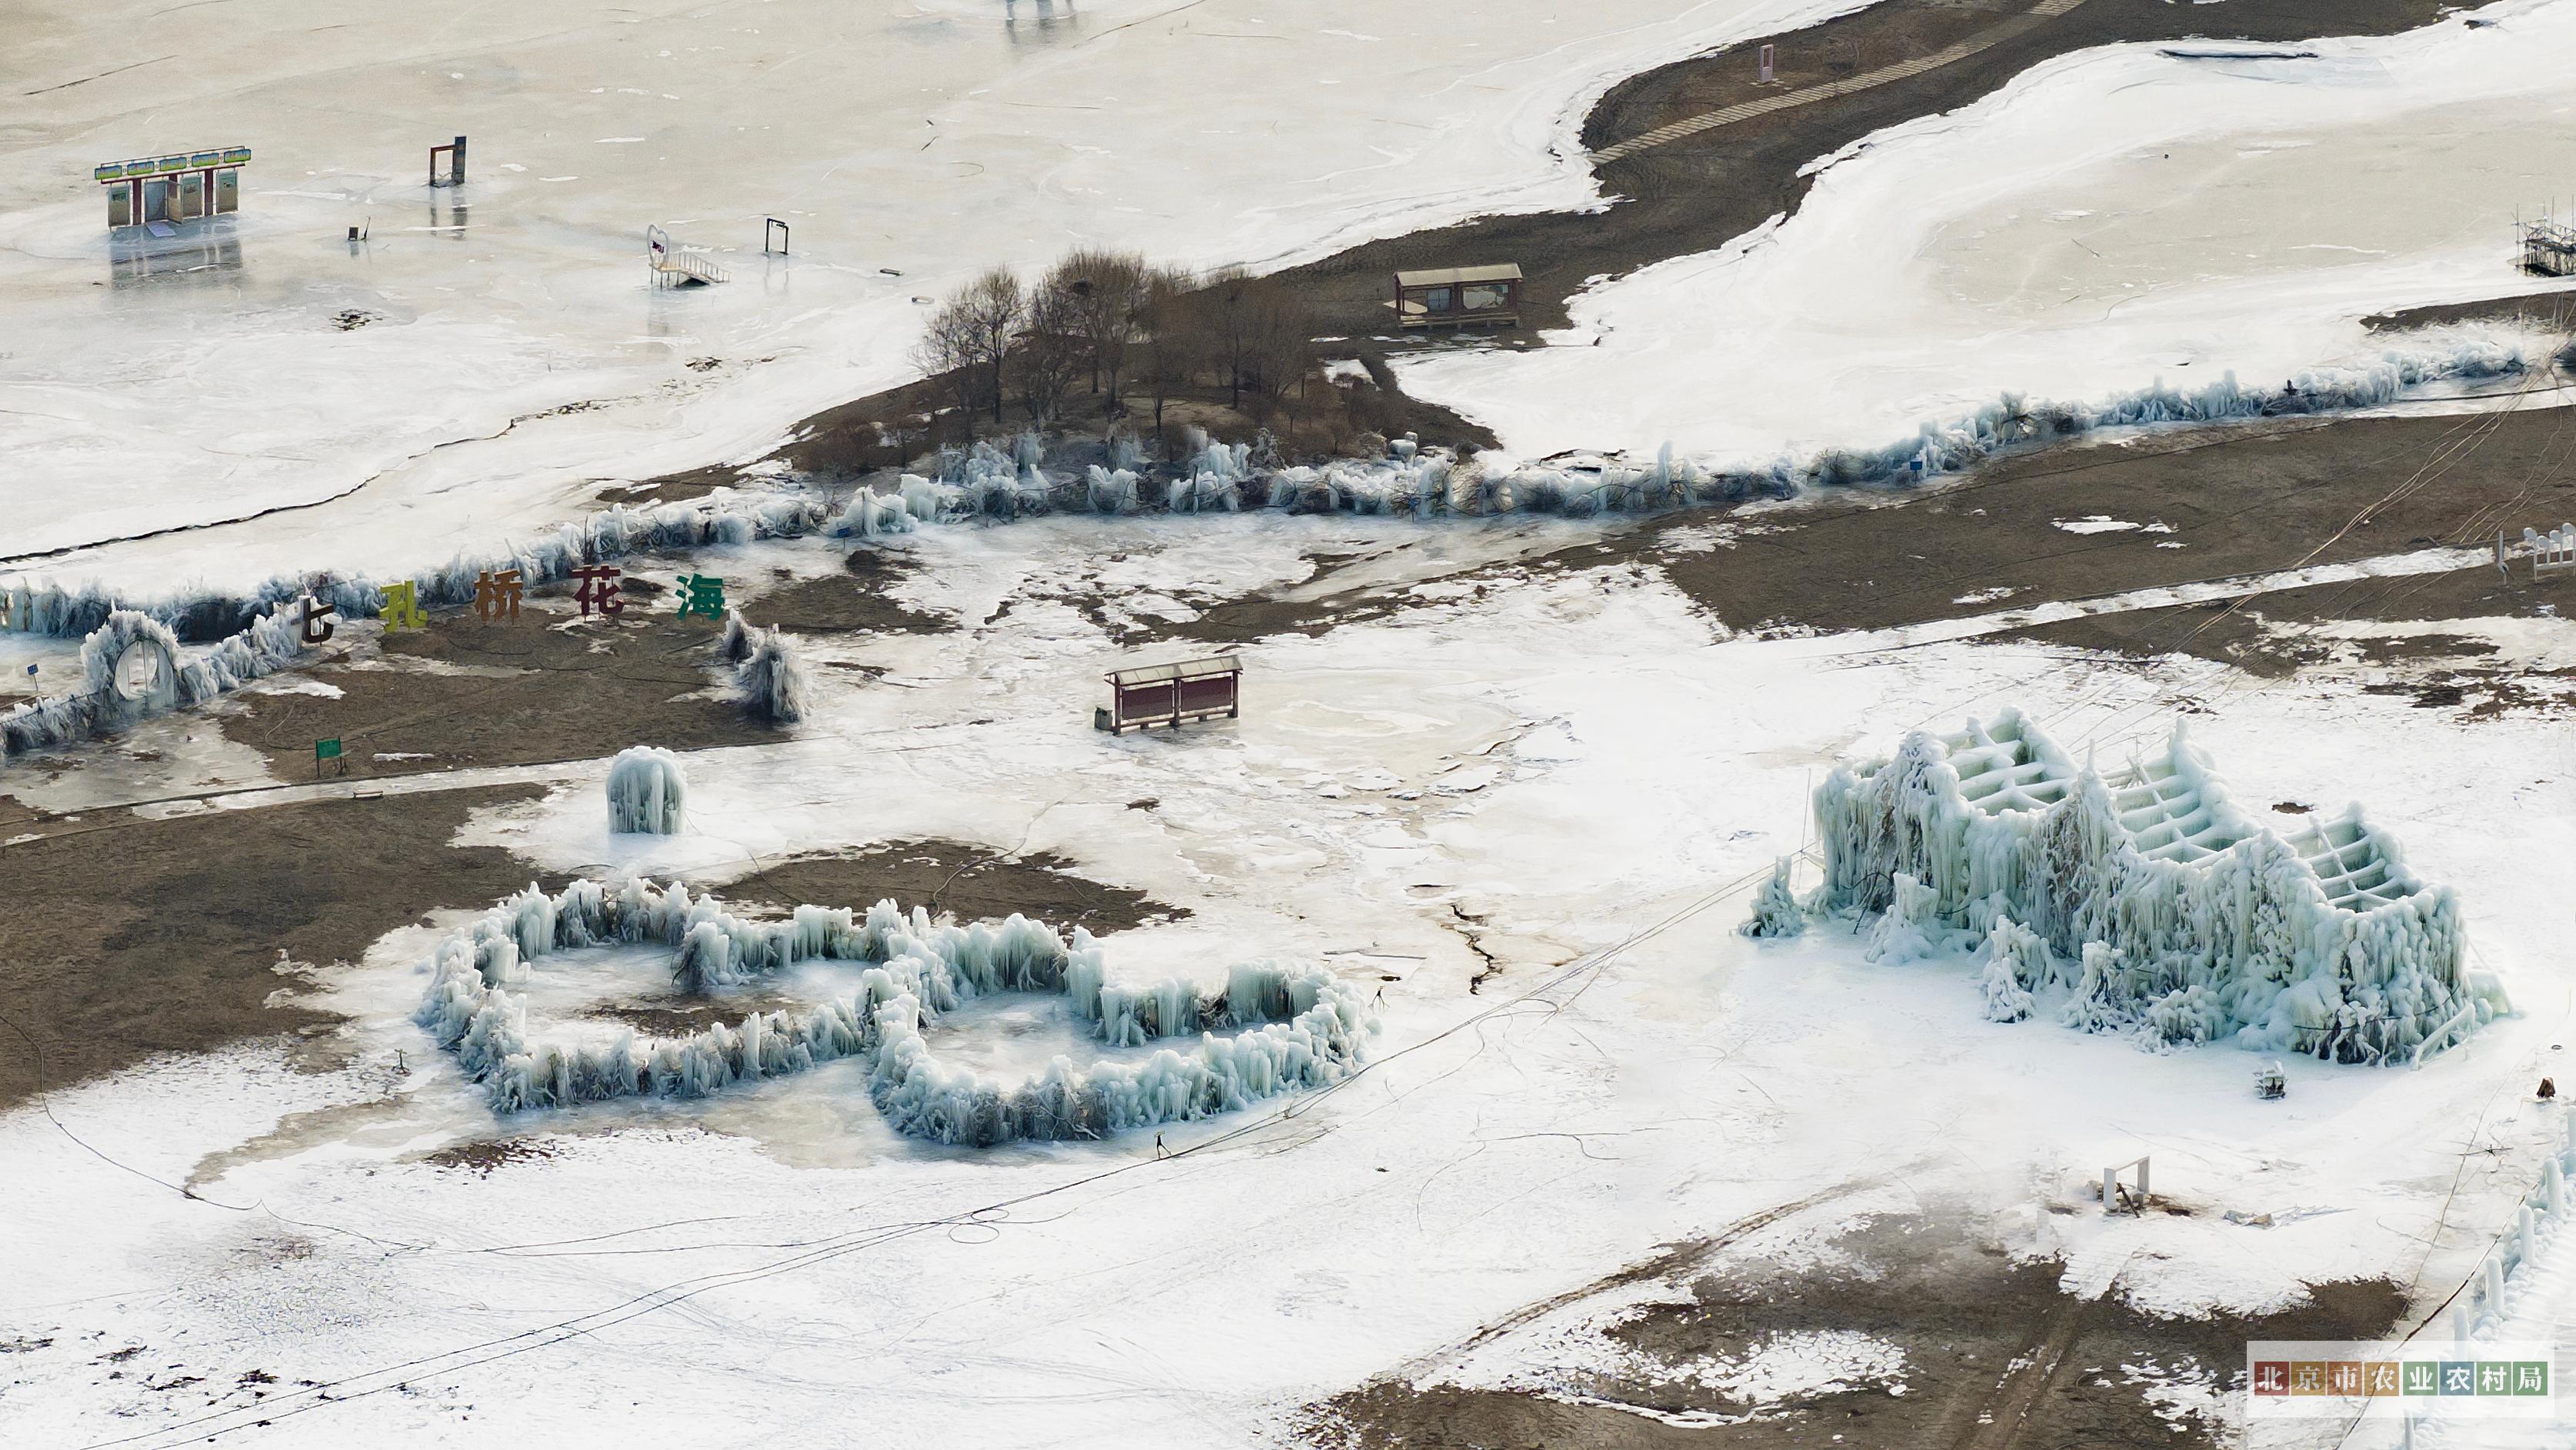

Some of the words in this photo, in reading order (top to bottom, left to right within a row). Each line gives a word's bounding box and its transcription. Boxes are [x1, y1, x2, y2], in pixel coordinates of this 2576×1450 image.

[291, 565, 725, 643] 七孔桥花海
